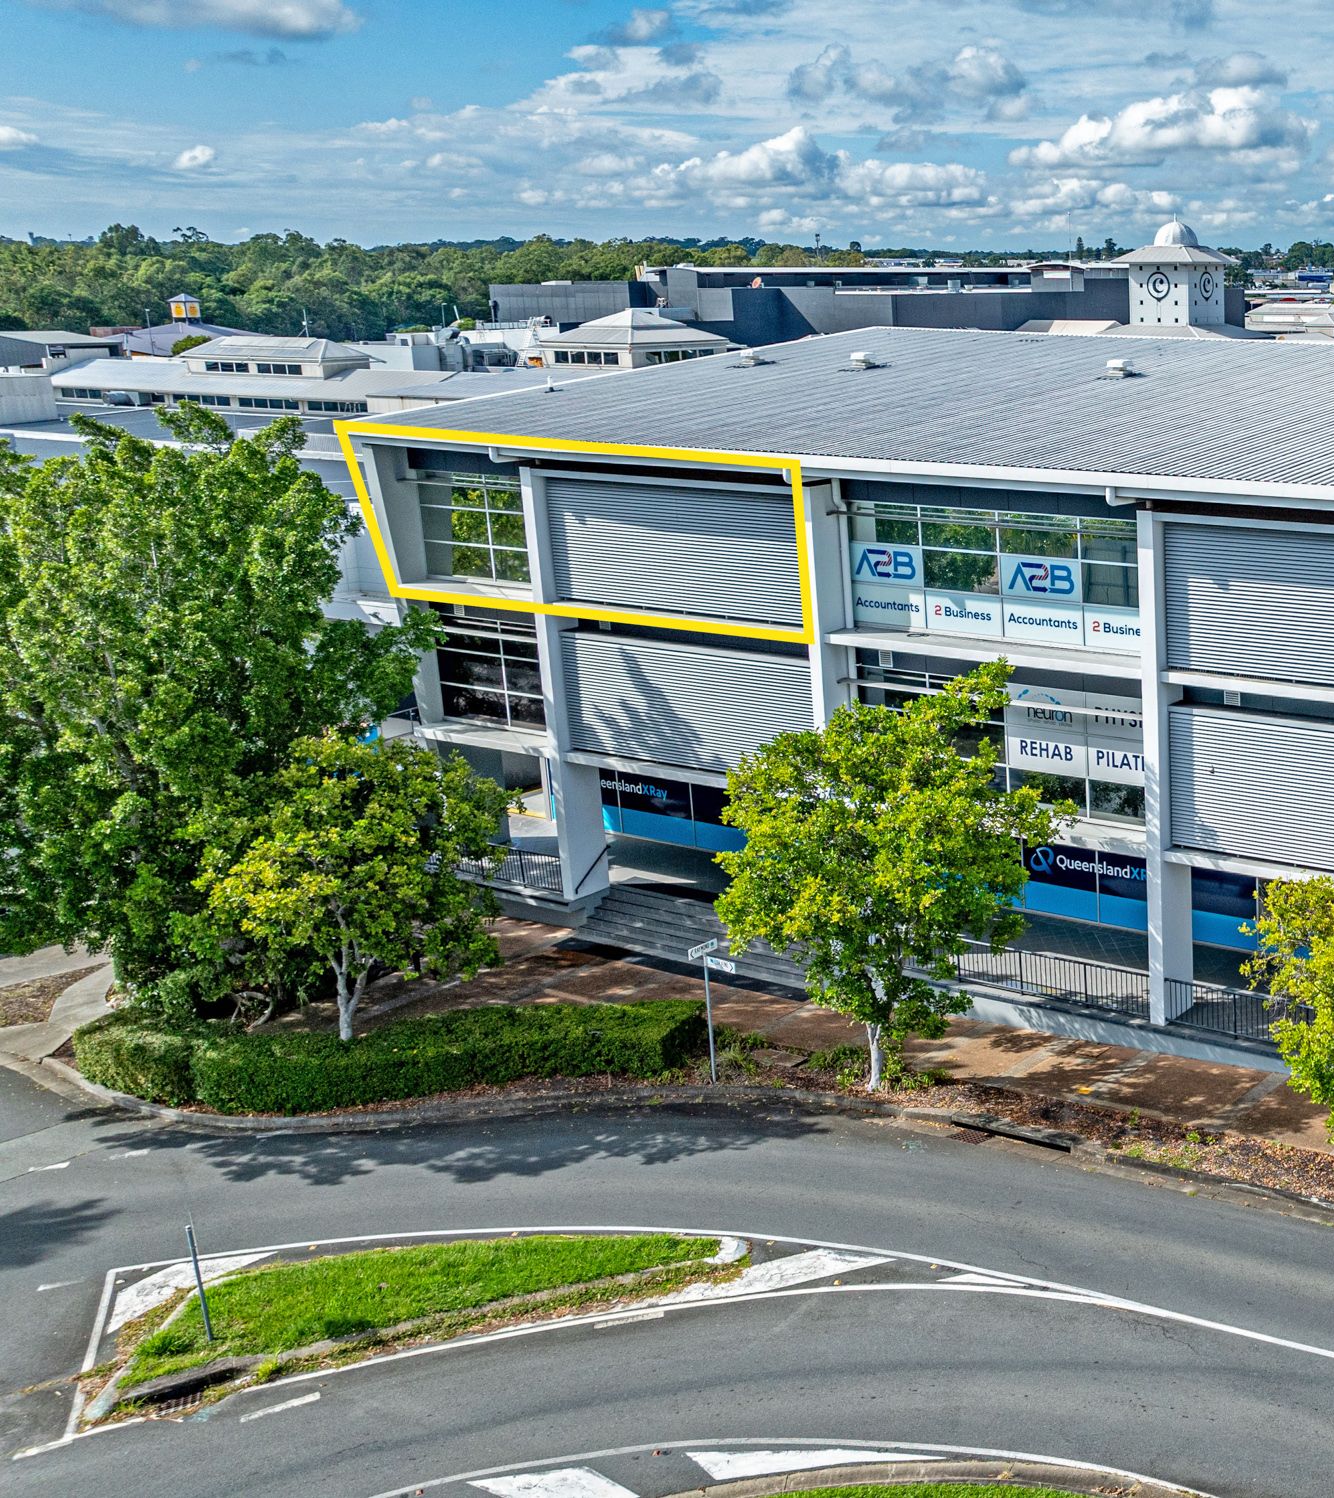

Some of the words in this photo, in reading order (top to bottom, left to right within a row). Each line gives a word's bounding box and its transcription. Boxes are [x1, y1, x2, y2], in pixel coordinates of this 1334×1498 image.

[855, 548, 916, 580] A2B
[1008, 561, 1075, 595] A2B
[855, 596, 920, 613] Accountants
[934, 604, 942, 616] 2
[944, 606, 992, 621] Business
[1008, 612, 1078, 630] Accountants
[1092, 620, 1101, 633] 2
[1027, 706, 1073, 723] neuron
[1020, 739, 1073, 761] REHAB
